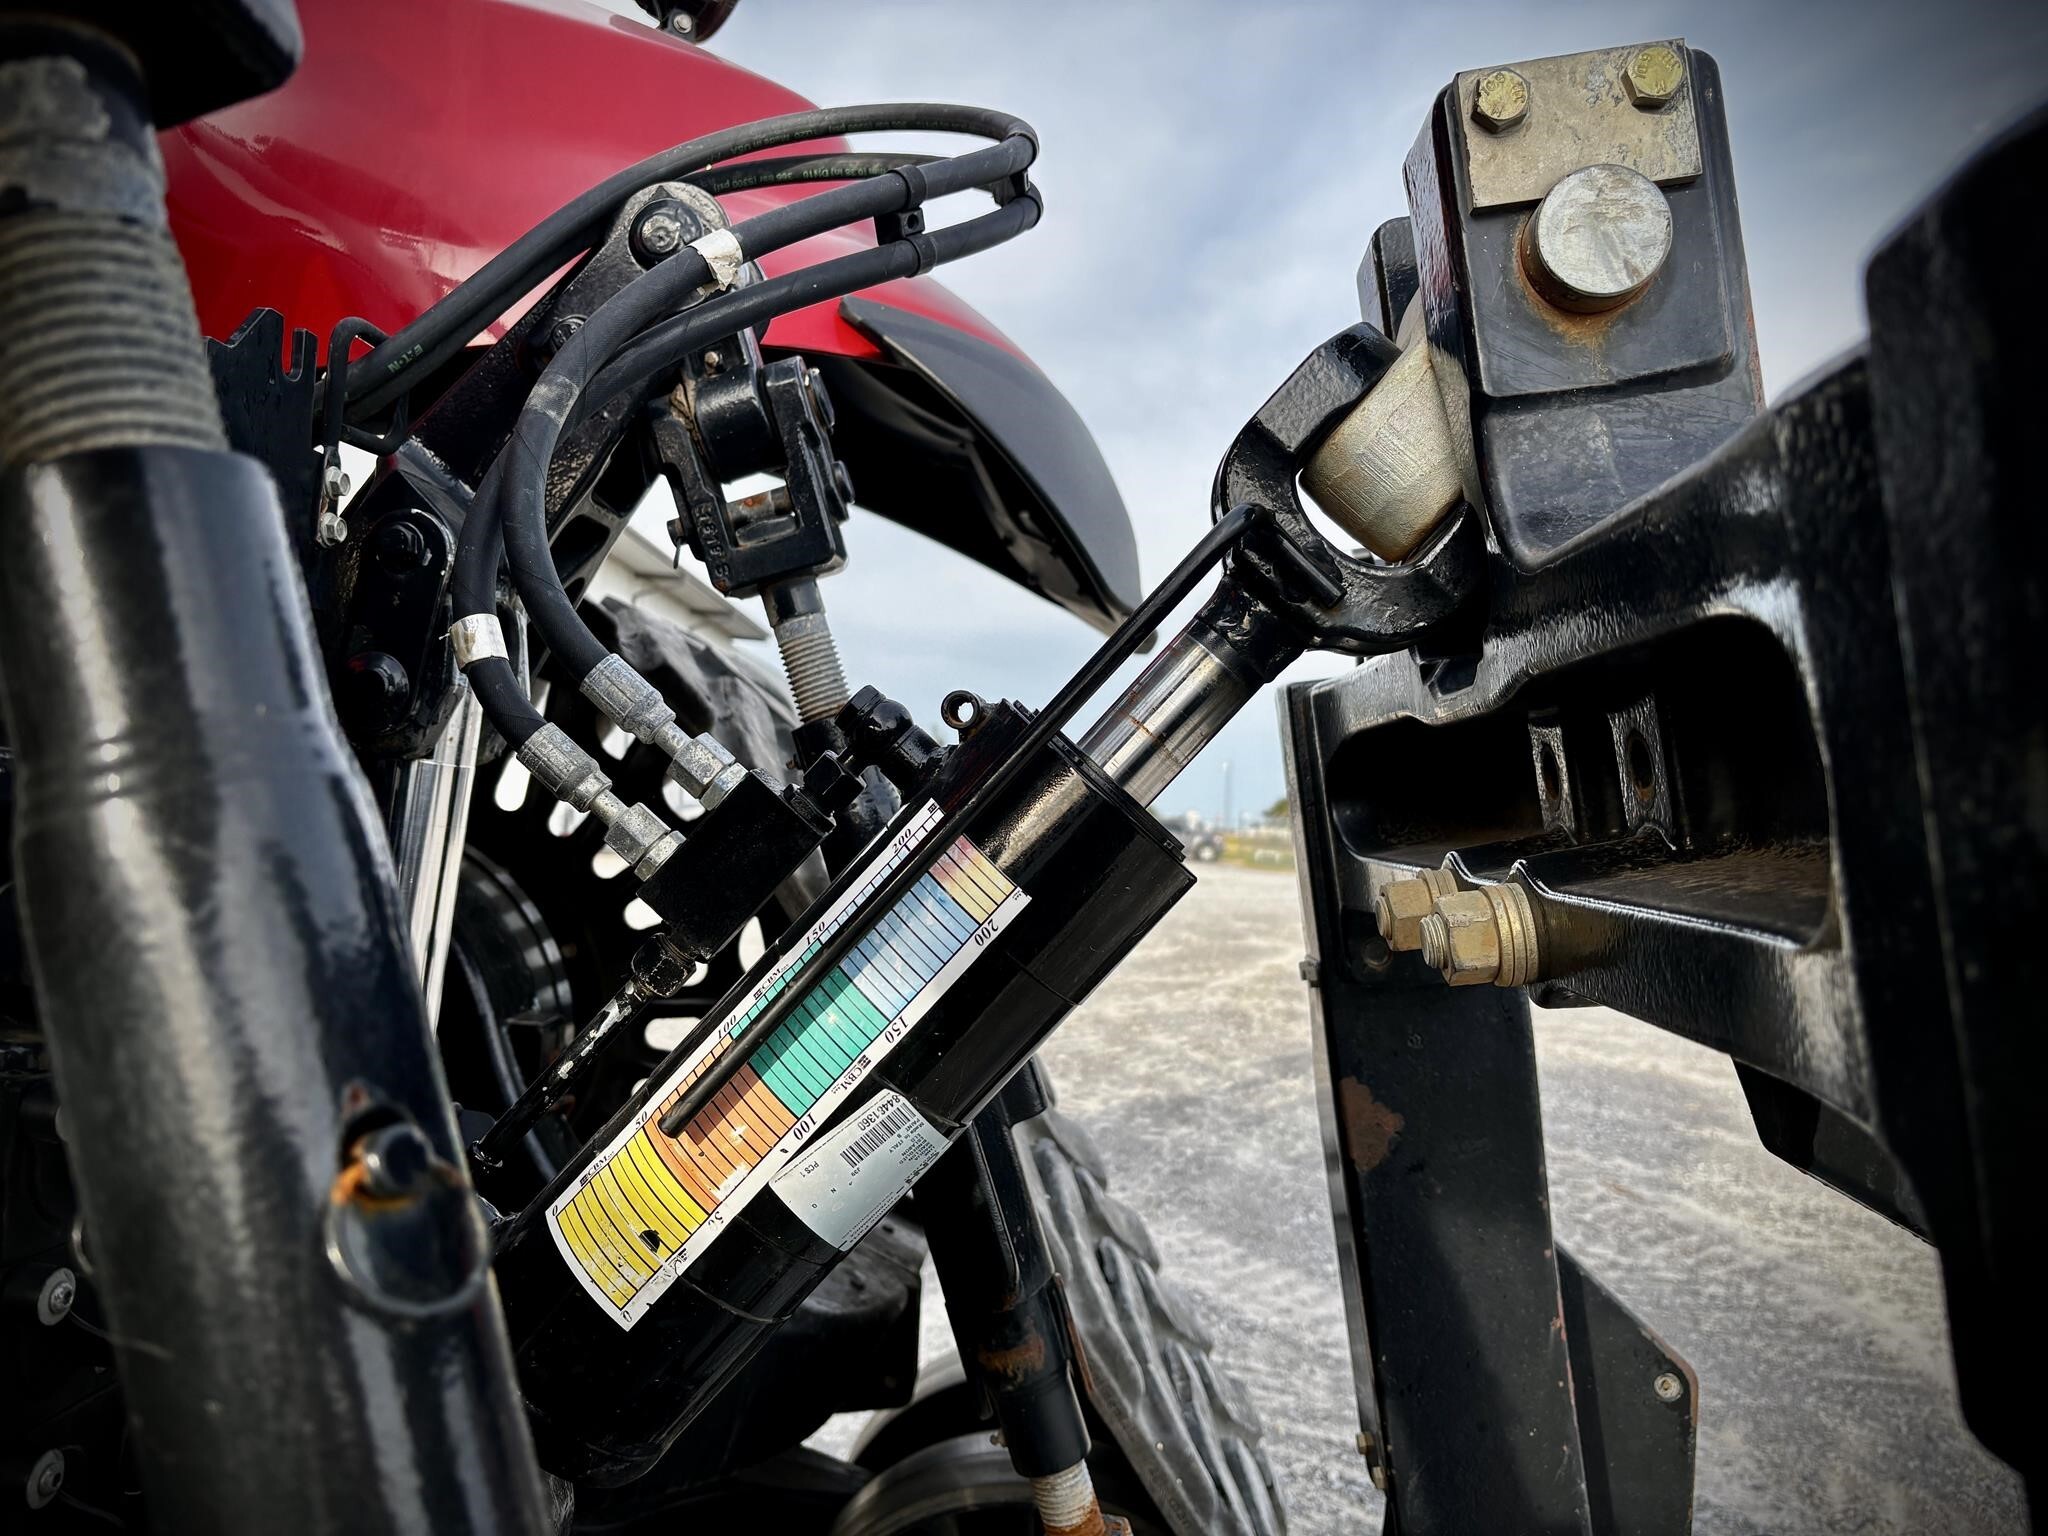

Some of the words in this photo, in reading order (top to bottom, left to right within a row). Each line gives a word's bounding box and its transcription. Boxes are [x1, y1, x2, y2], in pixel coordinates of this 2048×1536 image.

[887, 826, 915, 854] 200
[801, 920, 829, 946] 150
[970, 918, 1000, 948] 200
[713, 1014, 739, 1039] 100
[880, 1015, 910, 1044] 150
[631, 1110, 650, 1130] 50
[790, 1112, 819, 1141] 100
[904, 1117, 920, 1132] PAINT
[887, 1139, 903, 1153] ITALY
[803, 1160, 819, 1174] PCS
[548, 1203, 562, 1217] 0
[620, 1309, 634, 1323] 0
